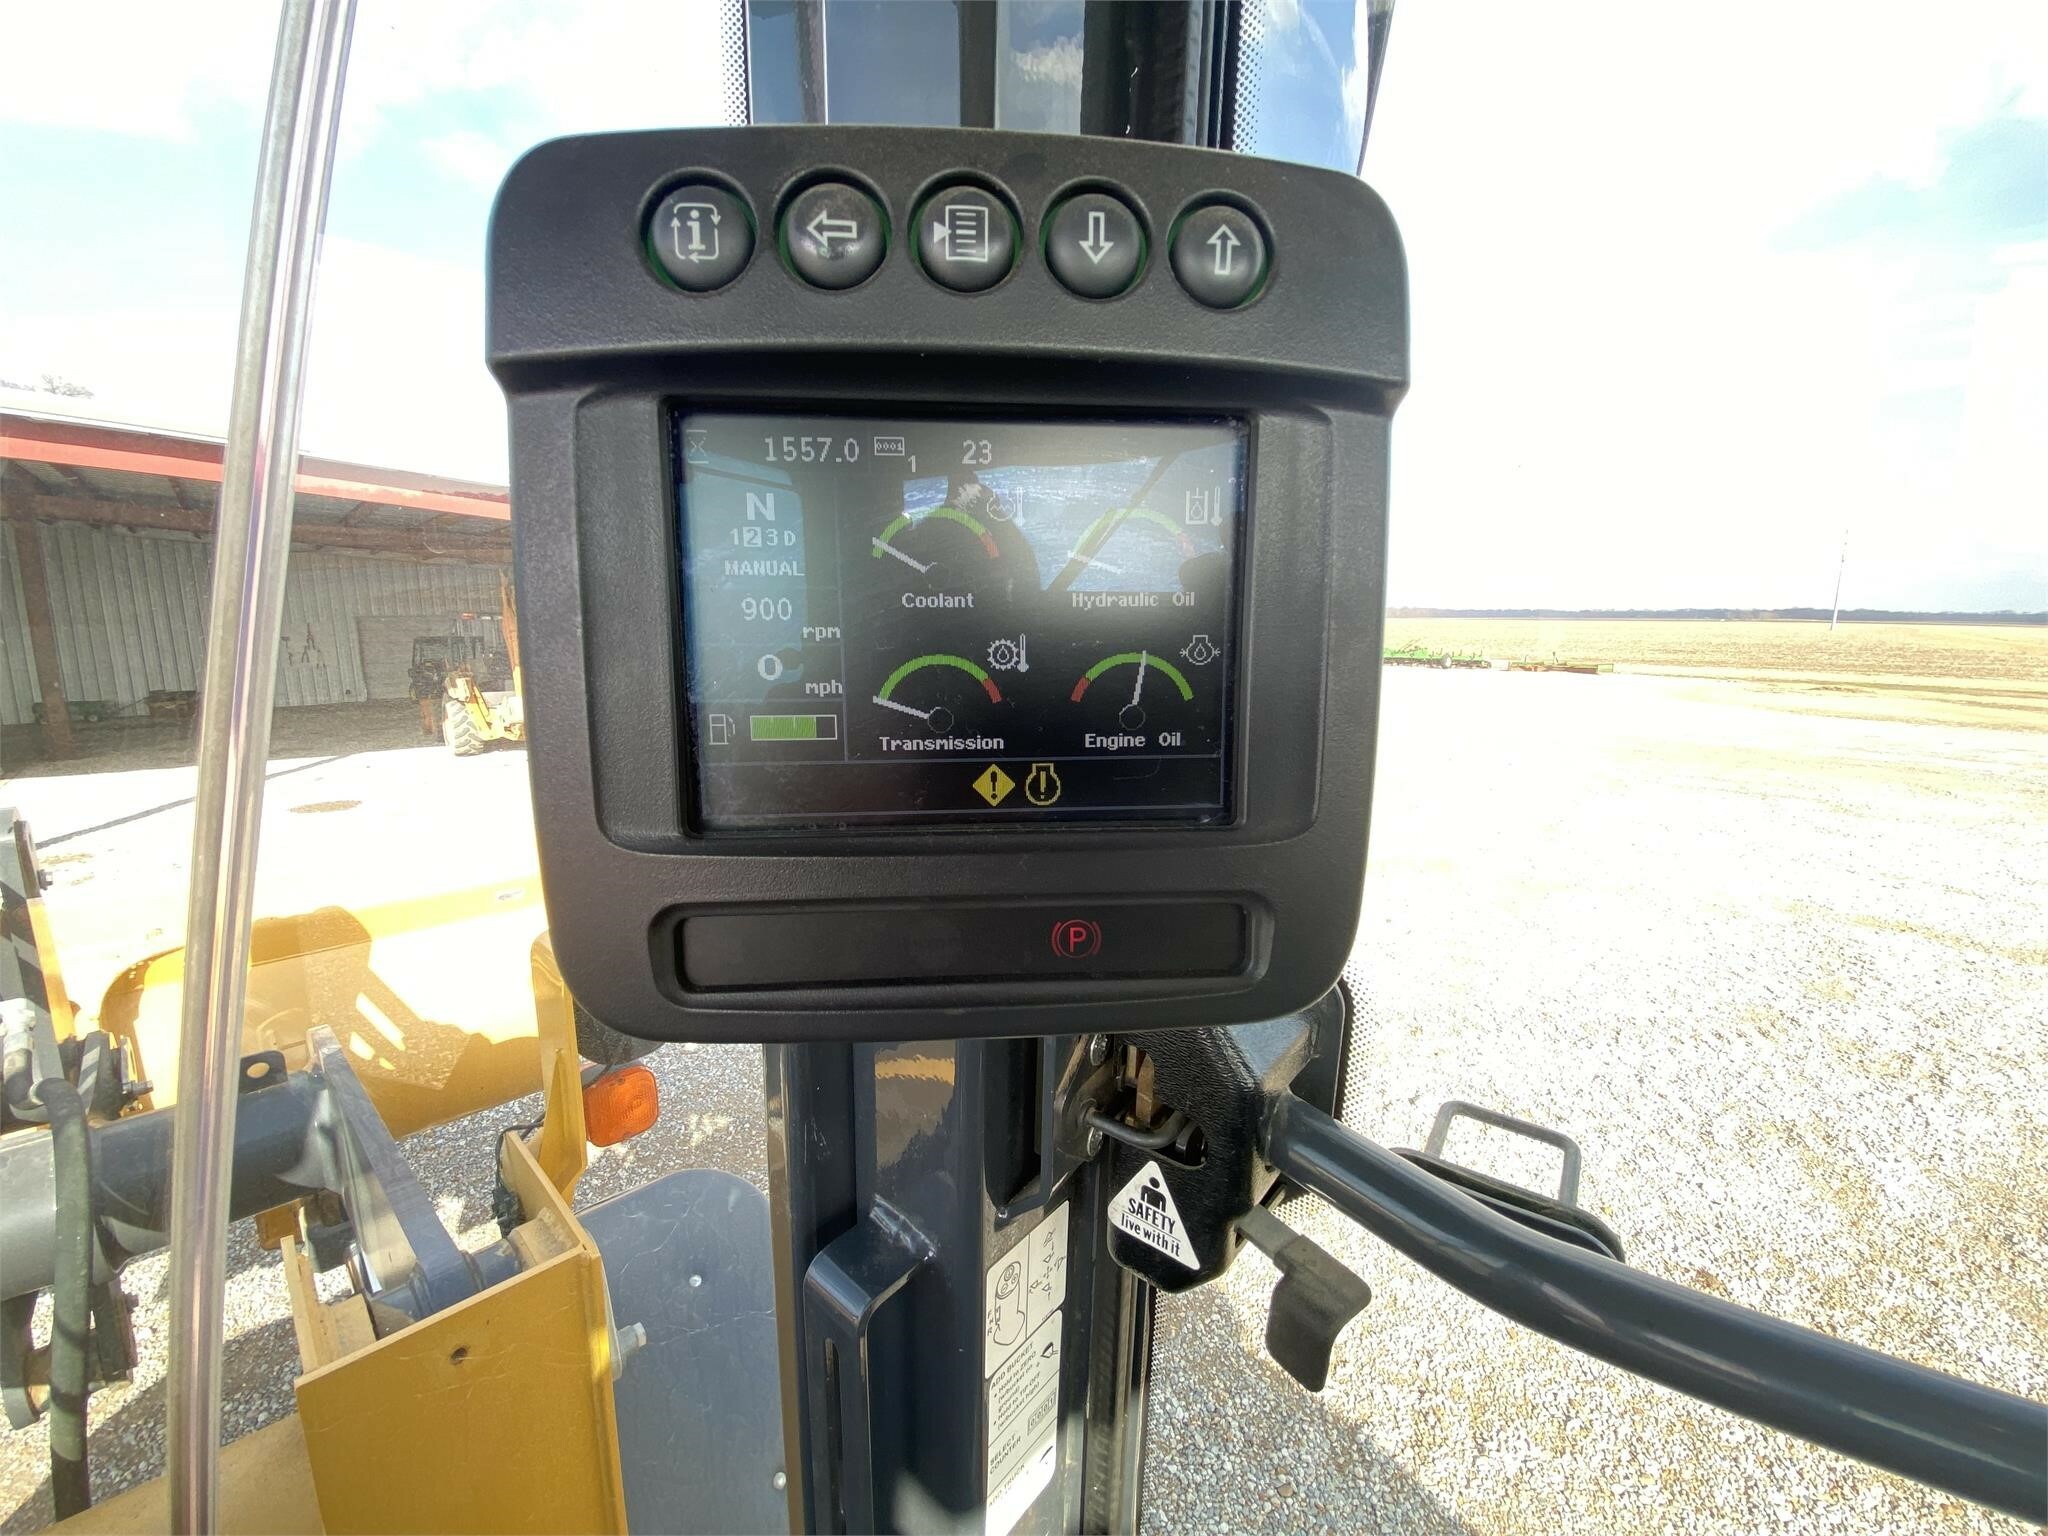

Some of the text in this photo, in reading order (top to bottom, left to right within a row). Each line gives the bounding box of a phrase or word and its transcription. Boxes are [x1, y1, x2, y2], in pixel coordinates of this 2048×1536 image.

[764, 436, 860, 463] 1557.0
[962, 439, 992, 464] 23
[908, 455, 916, 473] 1
[746, 492, 775, 520] N
[725, 559, 805, 576] MANUAL
[741, 597, 792, 621] 900
[901, 592, 975, 609] Coolant
[1071, 591, 1195, 611] Hydraulic Oil
[803, 625, 841, 641] rpm
[757, 654, 783, 681] 0
[805, 679, 843, 698] mph
[879, 735, 1005, 751] Transmission
[1085, 732, 1181, 750] Engine Oil
[1069, 927, 1087, 953] P
[1128, 1197, 1176, 1235] SAFETY
[1121, 1213, 1181, 1258] live with it
